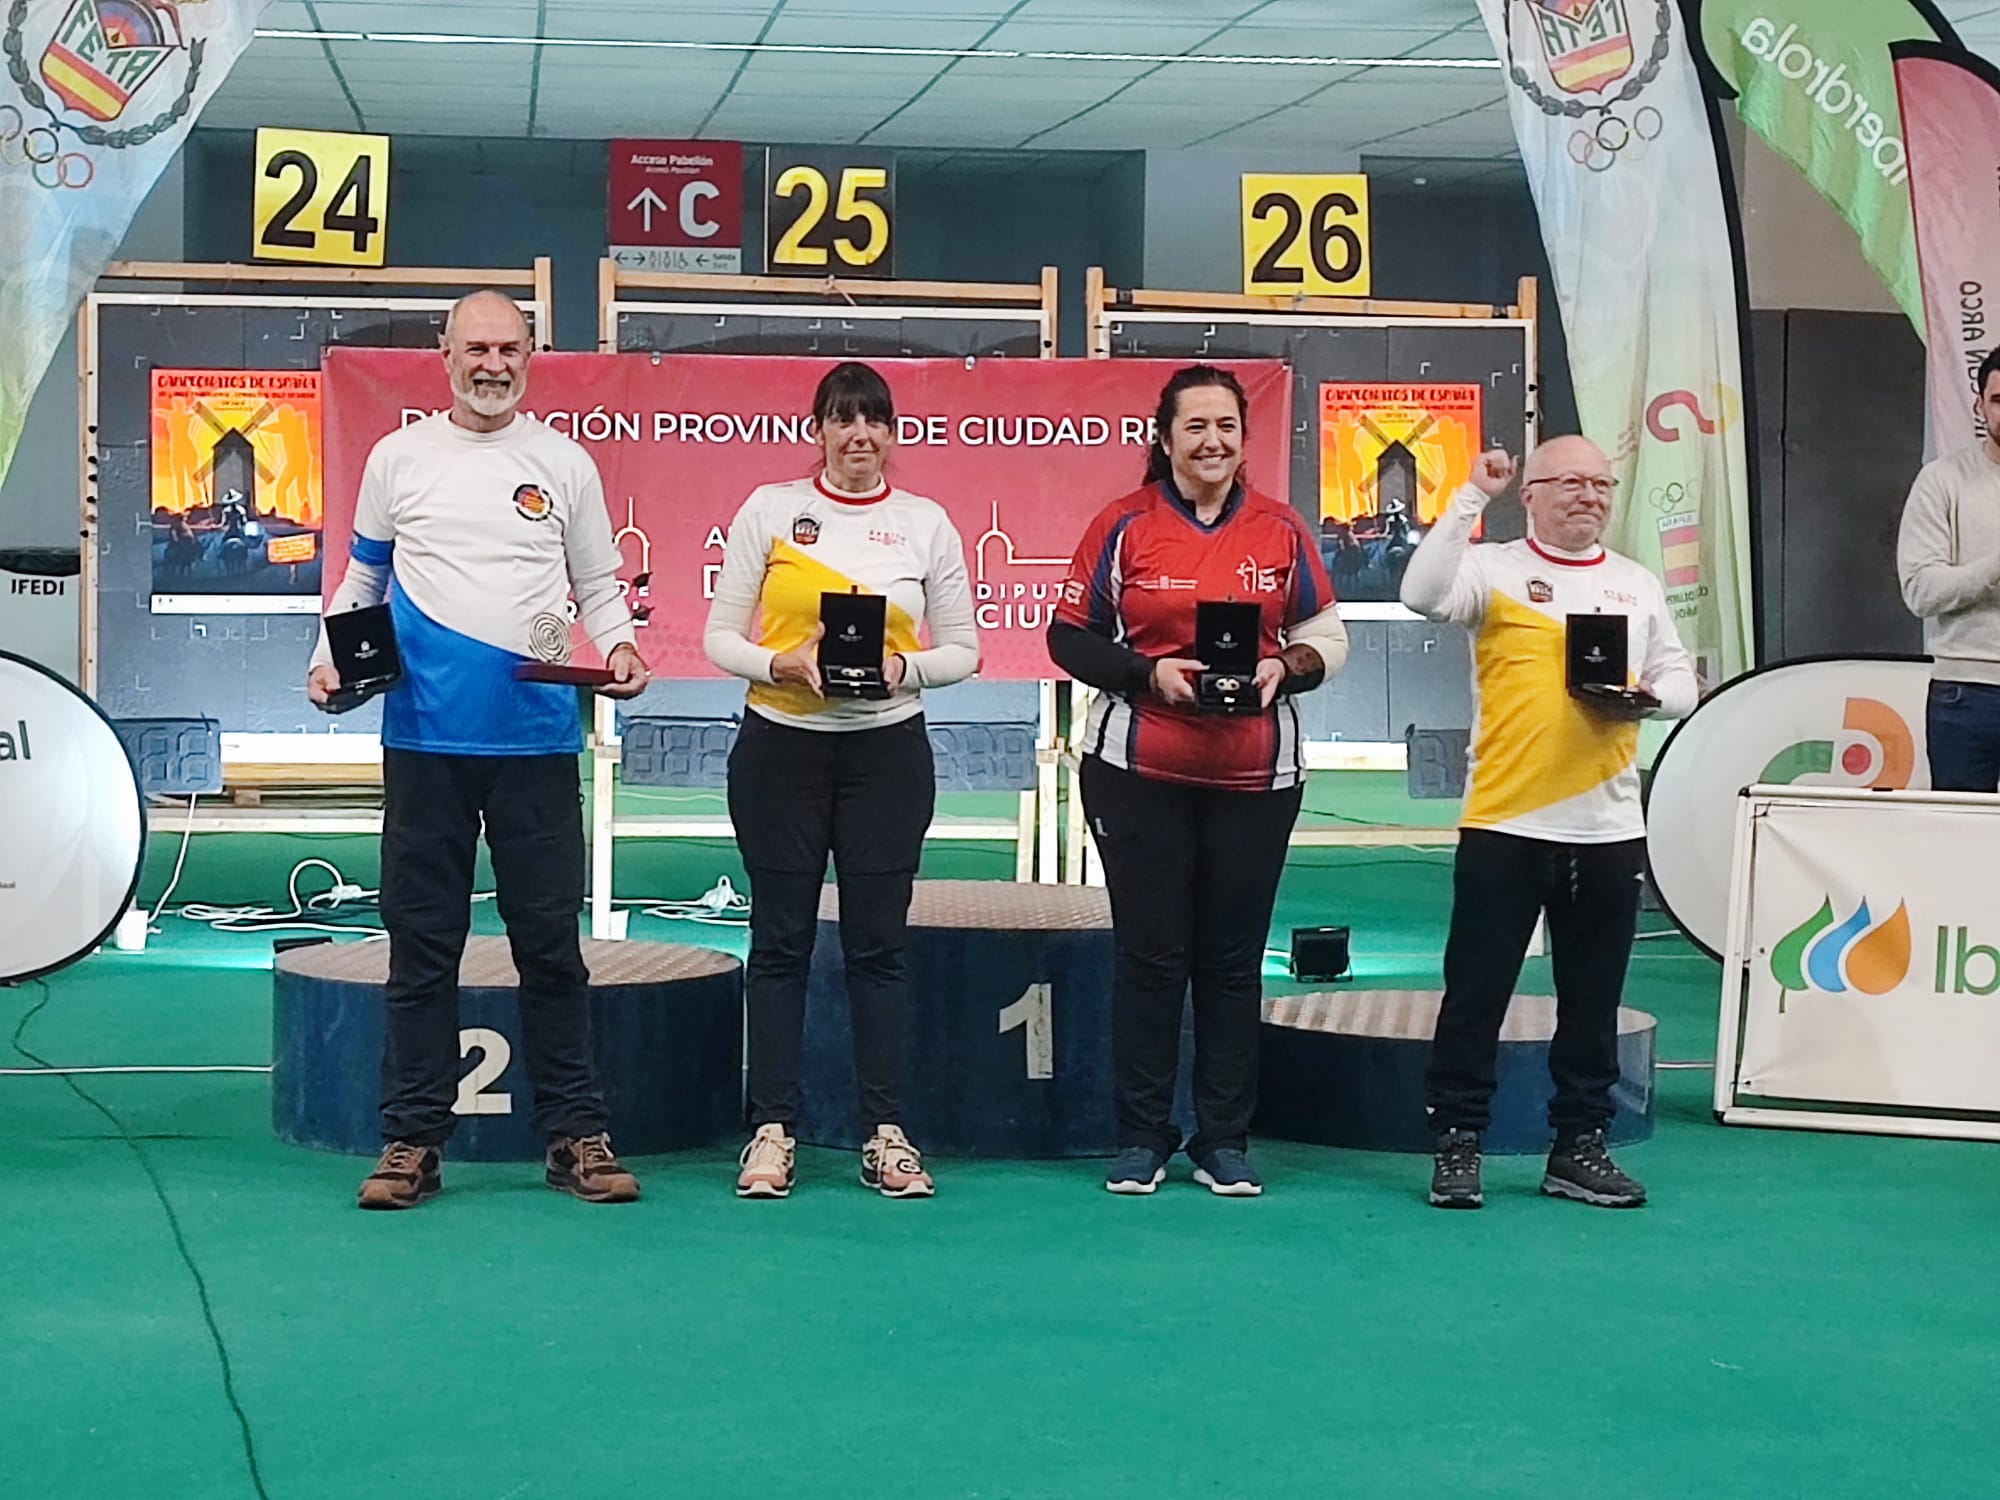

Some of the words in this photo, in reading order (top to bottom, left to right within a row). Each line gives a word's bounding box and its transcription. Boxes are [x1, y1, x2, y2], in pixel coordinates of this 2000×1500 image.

[60, 0, 162, 90] FETA
[260, 149, 379, 253] 24
[679, 180, 720, 238] C
[772, 166, 890, 267] 25
[1250, 192, 1362, 283] 26
[653, 412, 818, 445] PROVINC
[896, 416, 949, 445] DE
[958, 416, 1110, 446] CIUDAD
[11, 578, 65, 596] IFEDI
[976, 583, 1065, 600] DIPUT
[976, 603, 1057, 630] CIU
[1934, 925, 2000, 996] Ib
[999, 983, 1053, 1079] 1
[449, 1028, 512, 1115] 2
